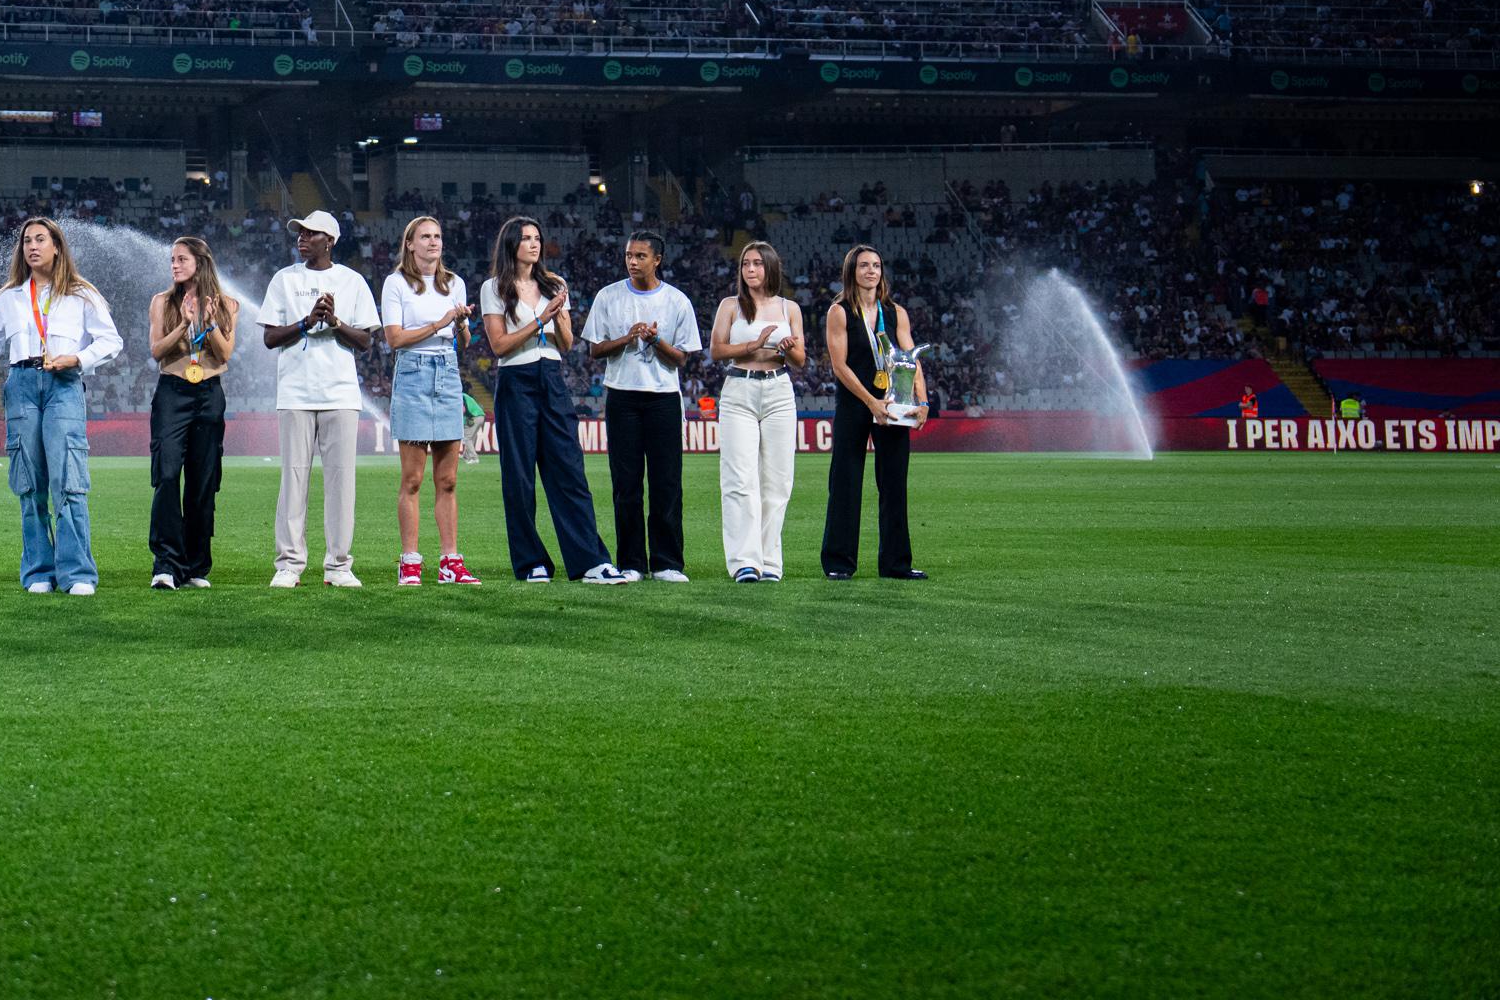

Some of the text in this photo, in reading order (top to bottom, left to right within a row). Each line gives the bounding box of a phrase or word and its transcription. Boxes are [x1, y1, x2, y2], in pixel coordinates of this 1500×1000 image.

[90, 55, 132, 70] Spotify
[194, 58, 236, 73] Spotify
[295, 58, 338, 74] Spotify
[425, 61, 467, 76] Spotify
[526, 62, 565, 77] Spotify
[623, 64, 662, 78] Spotify
[720, 66, 760, 80] Spotify
[841, 67, 882, 81] Spotify
[939, 69, 978, 82] Spotify
[1035, 71, 1074, 85] Spotify
[1131, 70, 1170, 86] Spotify
[1227, 419, 1238, 449] I
[1246, 419, 1299, 449] PER
[1384, 419, 1437, 450] ETS
